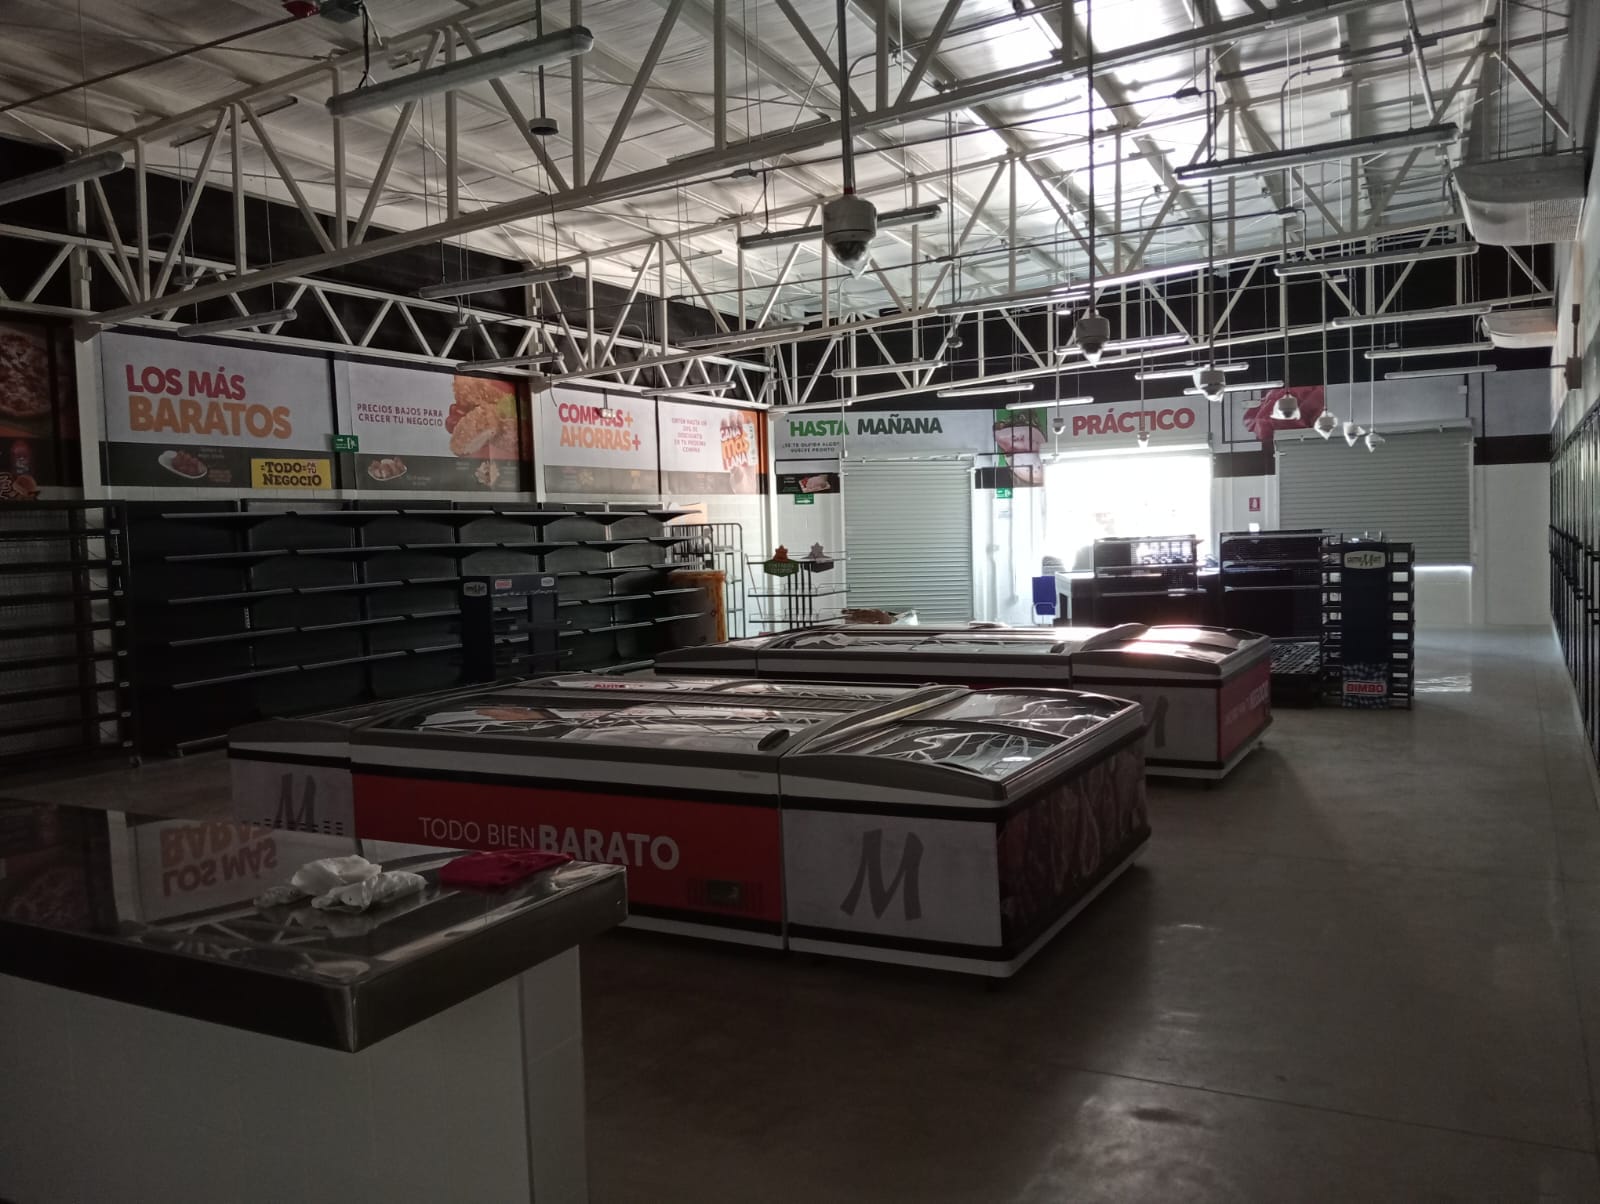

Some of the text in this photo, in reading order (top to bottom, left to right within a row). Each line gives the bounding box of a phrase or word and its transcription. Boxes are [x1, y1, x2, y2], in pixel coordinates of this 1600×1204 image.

[126, 365, 246, 400] LOS MÁS
[129, 396, 292, 439] BARATOS
[357, 403, 443, 418] PRECIOS BAJOS PARA
[359, 412, 443, 427] CRECER TU NEGOCIO
[790, 414, 943, 436] HASTA MAÑANA
[1073, 408, 1195, 436] PRÁCTICO
[265, 461, 302, 474] TODO
[263, 474, 322, 486] NEGOCIO
[1346, 684, 1384, 692] BIMBO
[418, 816, 680, 870] TODO BIEN BARATO
[840, 828, 923, 920] M
